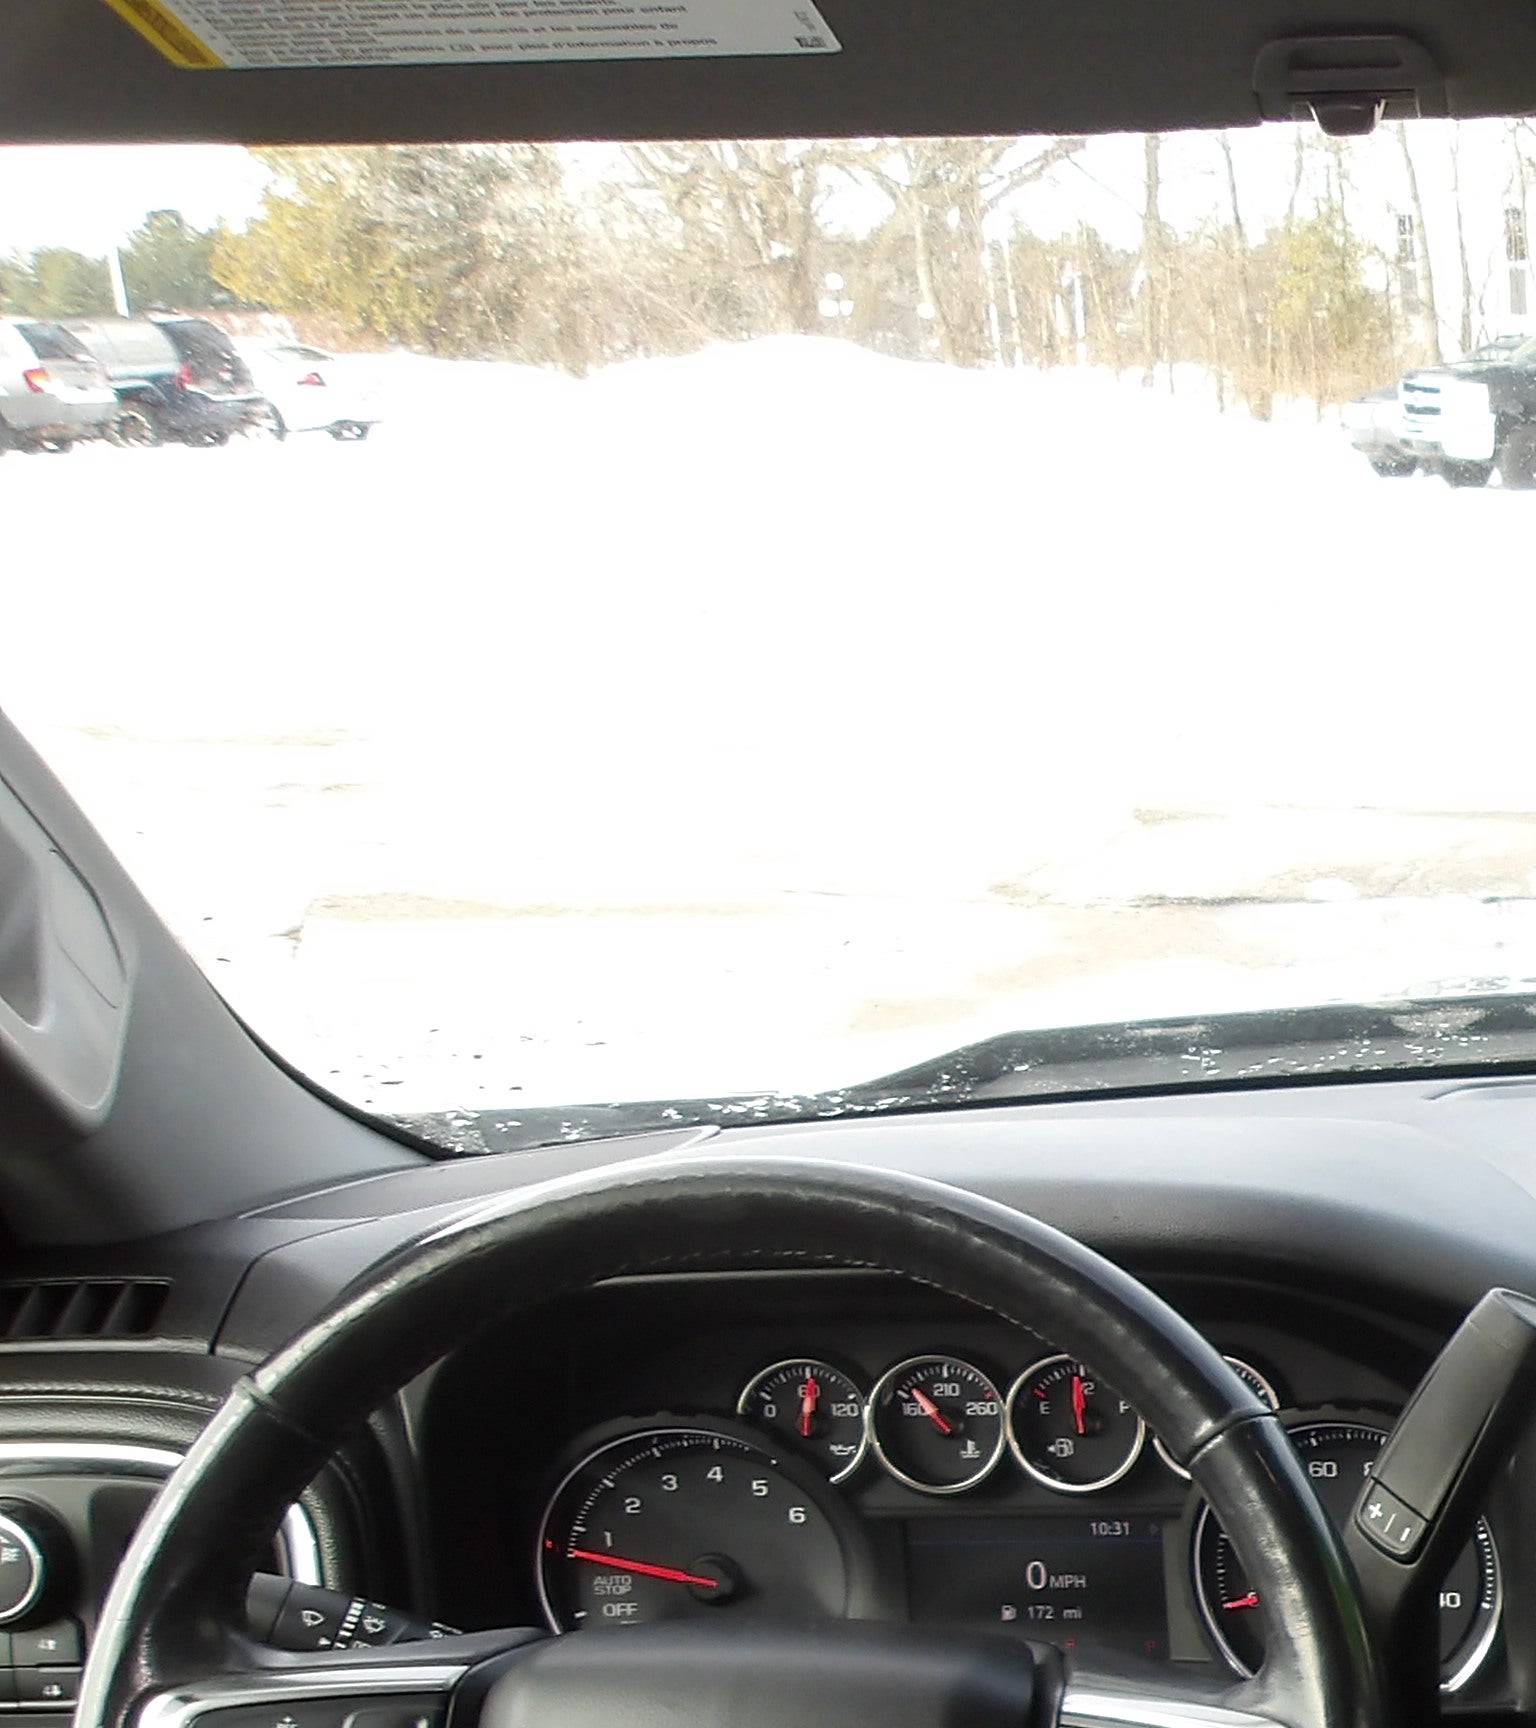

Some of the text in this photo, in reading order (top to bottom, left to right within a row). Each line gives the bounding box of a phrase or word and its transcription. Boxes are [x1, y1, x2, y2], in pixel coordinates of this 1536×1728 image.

[933, 1383, 960, 1397] 210
[764, 1405, 776, 1418] 0
[831, 1404, 859, 1417] 120
[966, 1403, 999, 1416] 260
[1039, 1402, 1050, 1415] E
[707, 1466, 723, 1483] 4
[1308, 1461, 1337, 1478] 60
[662, 1474, 678, 1491] 3
[752, 1479, 768, 1497] 5
[624, 1497, 641, 1514] 2
[789, 1506, 805, 1524] 6
[1090, 1521, 1130, 1536] 10:31
[593, 1574, 632, 1586] AUTO
[1026, 1561, 1087, 1590] 0 MPH
[593, 1585, 632, 1596] STOP
[603, 1602, 638, 1617] OFF
[1028, 1606, 1054, 1619] 172
